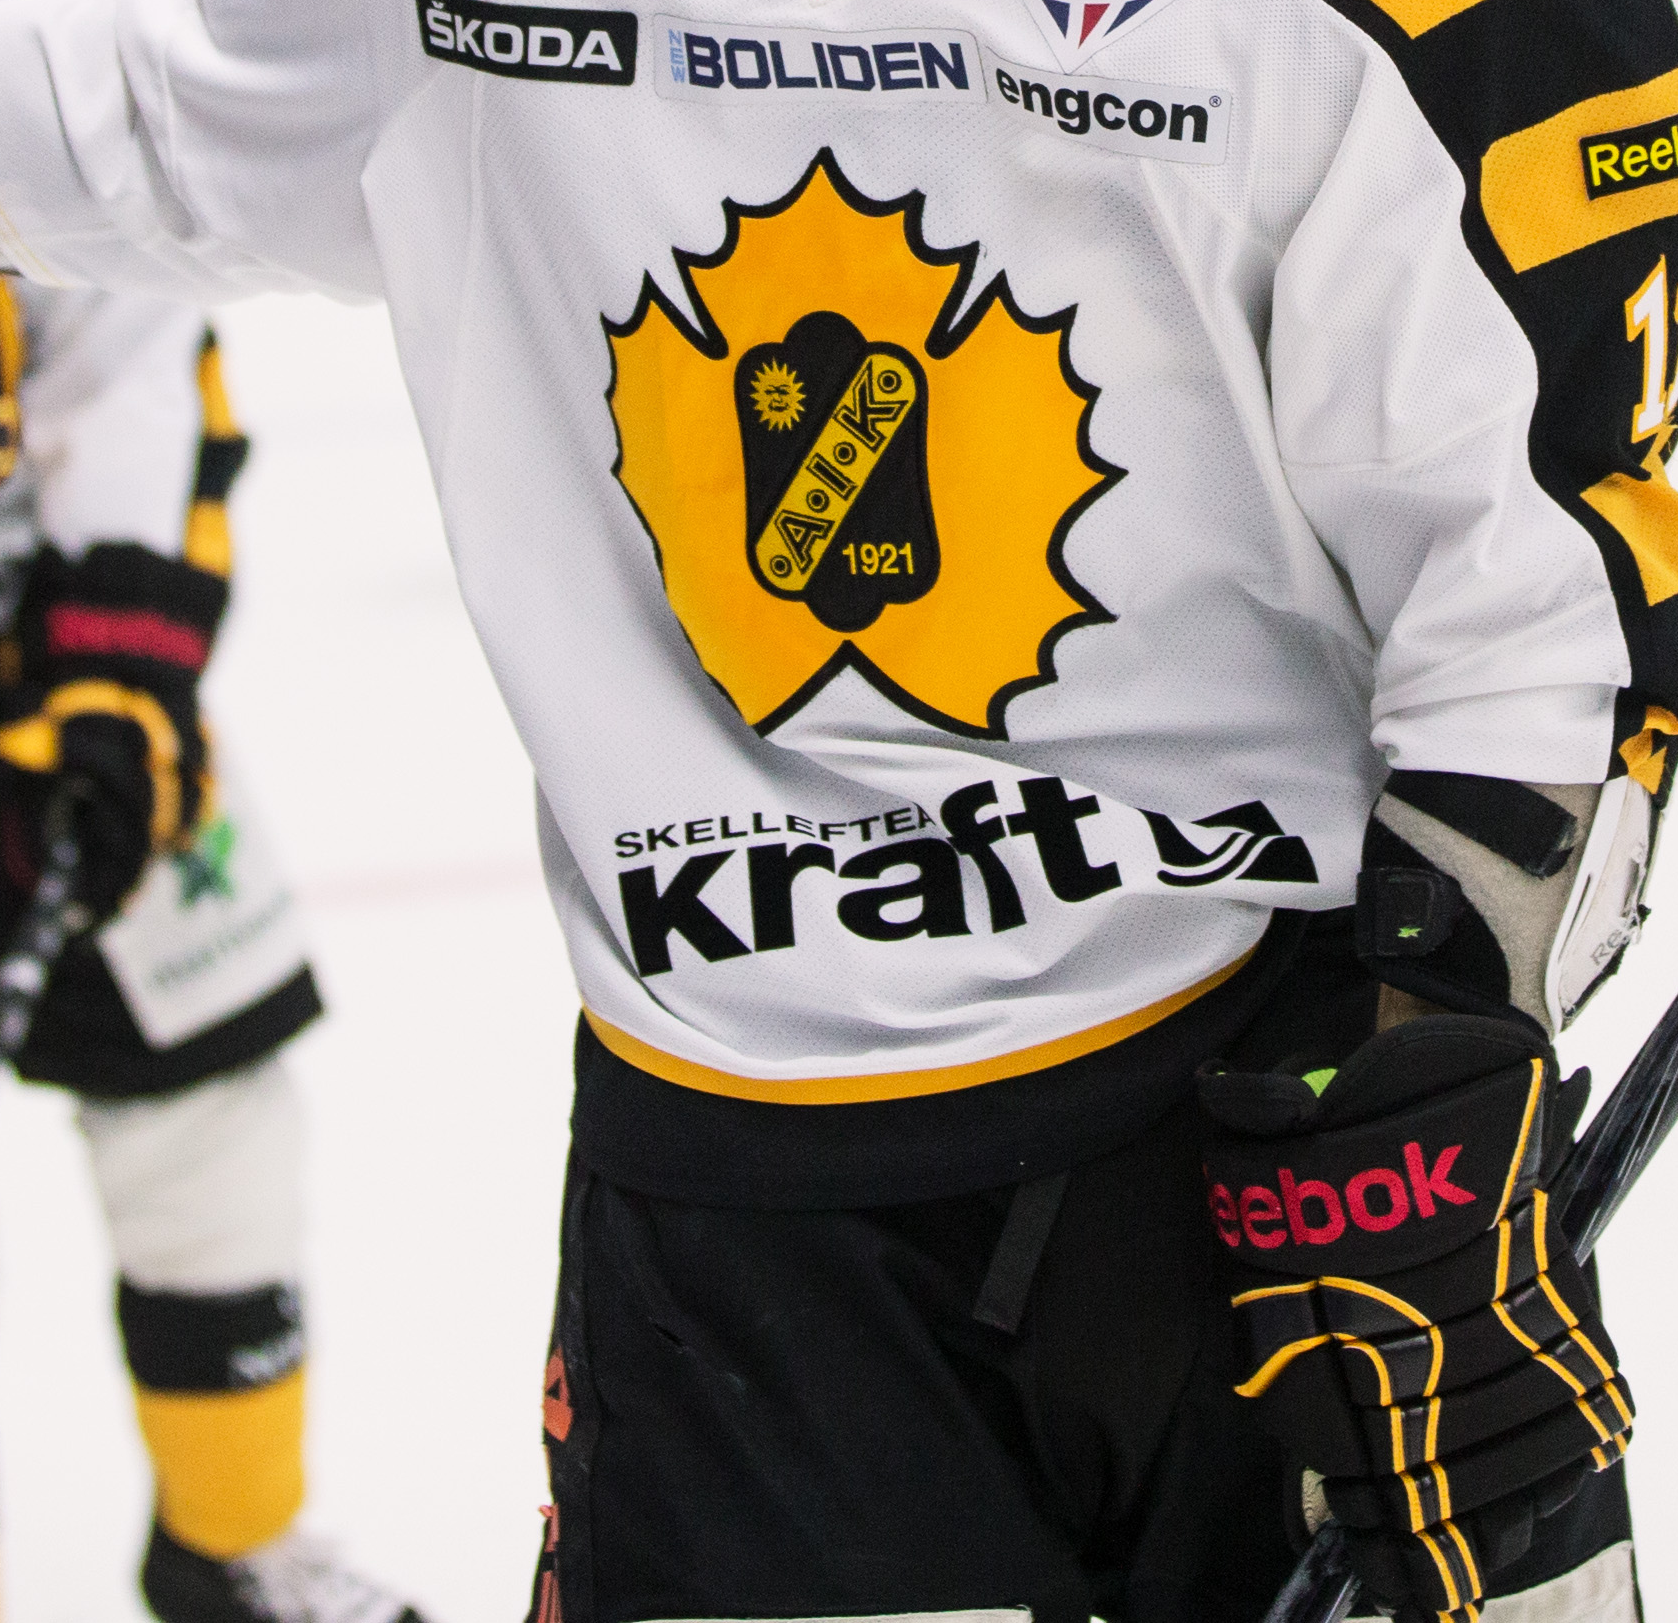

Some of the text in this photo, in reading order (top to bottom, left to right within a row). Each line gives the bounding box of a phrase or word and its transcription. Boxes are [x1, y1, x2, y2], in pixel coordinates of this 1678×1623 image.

[425, 0, 622, 73] ŠKODA
[684, 32, 970, 92] BOLIDEN
[995, 67, 1209, 144] engcon
[841, 542, 916, 576] 1921
[617, 777, 1123, 979] kraft
[1201, 1140, 1478, 1249] eebok
